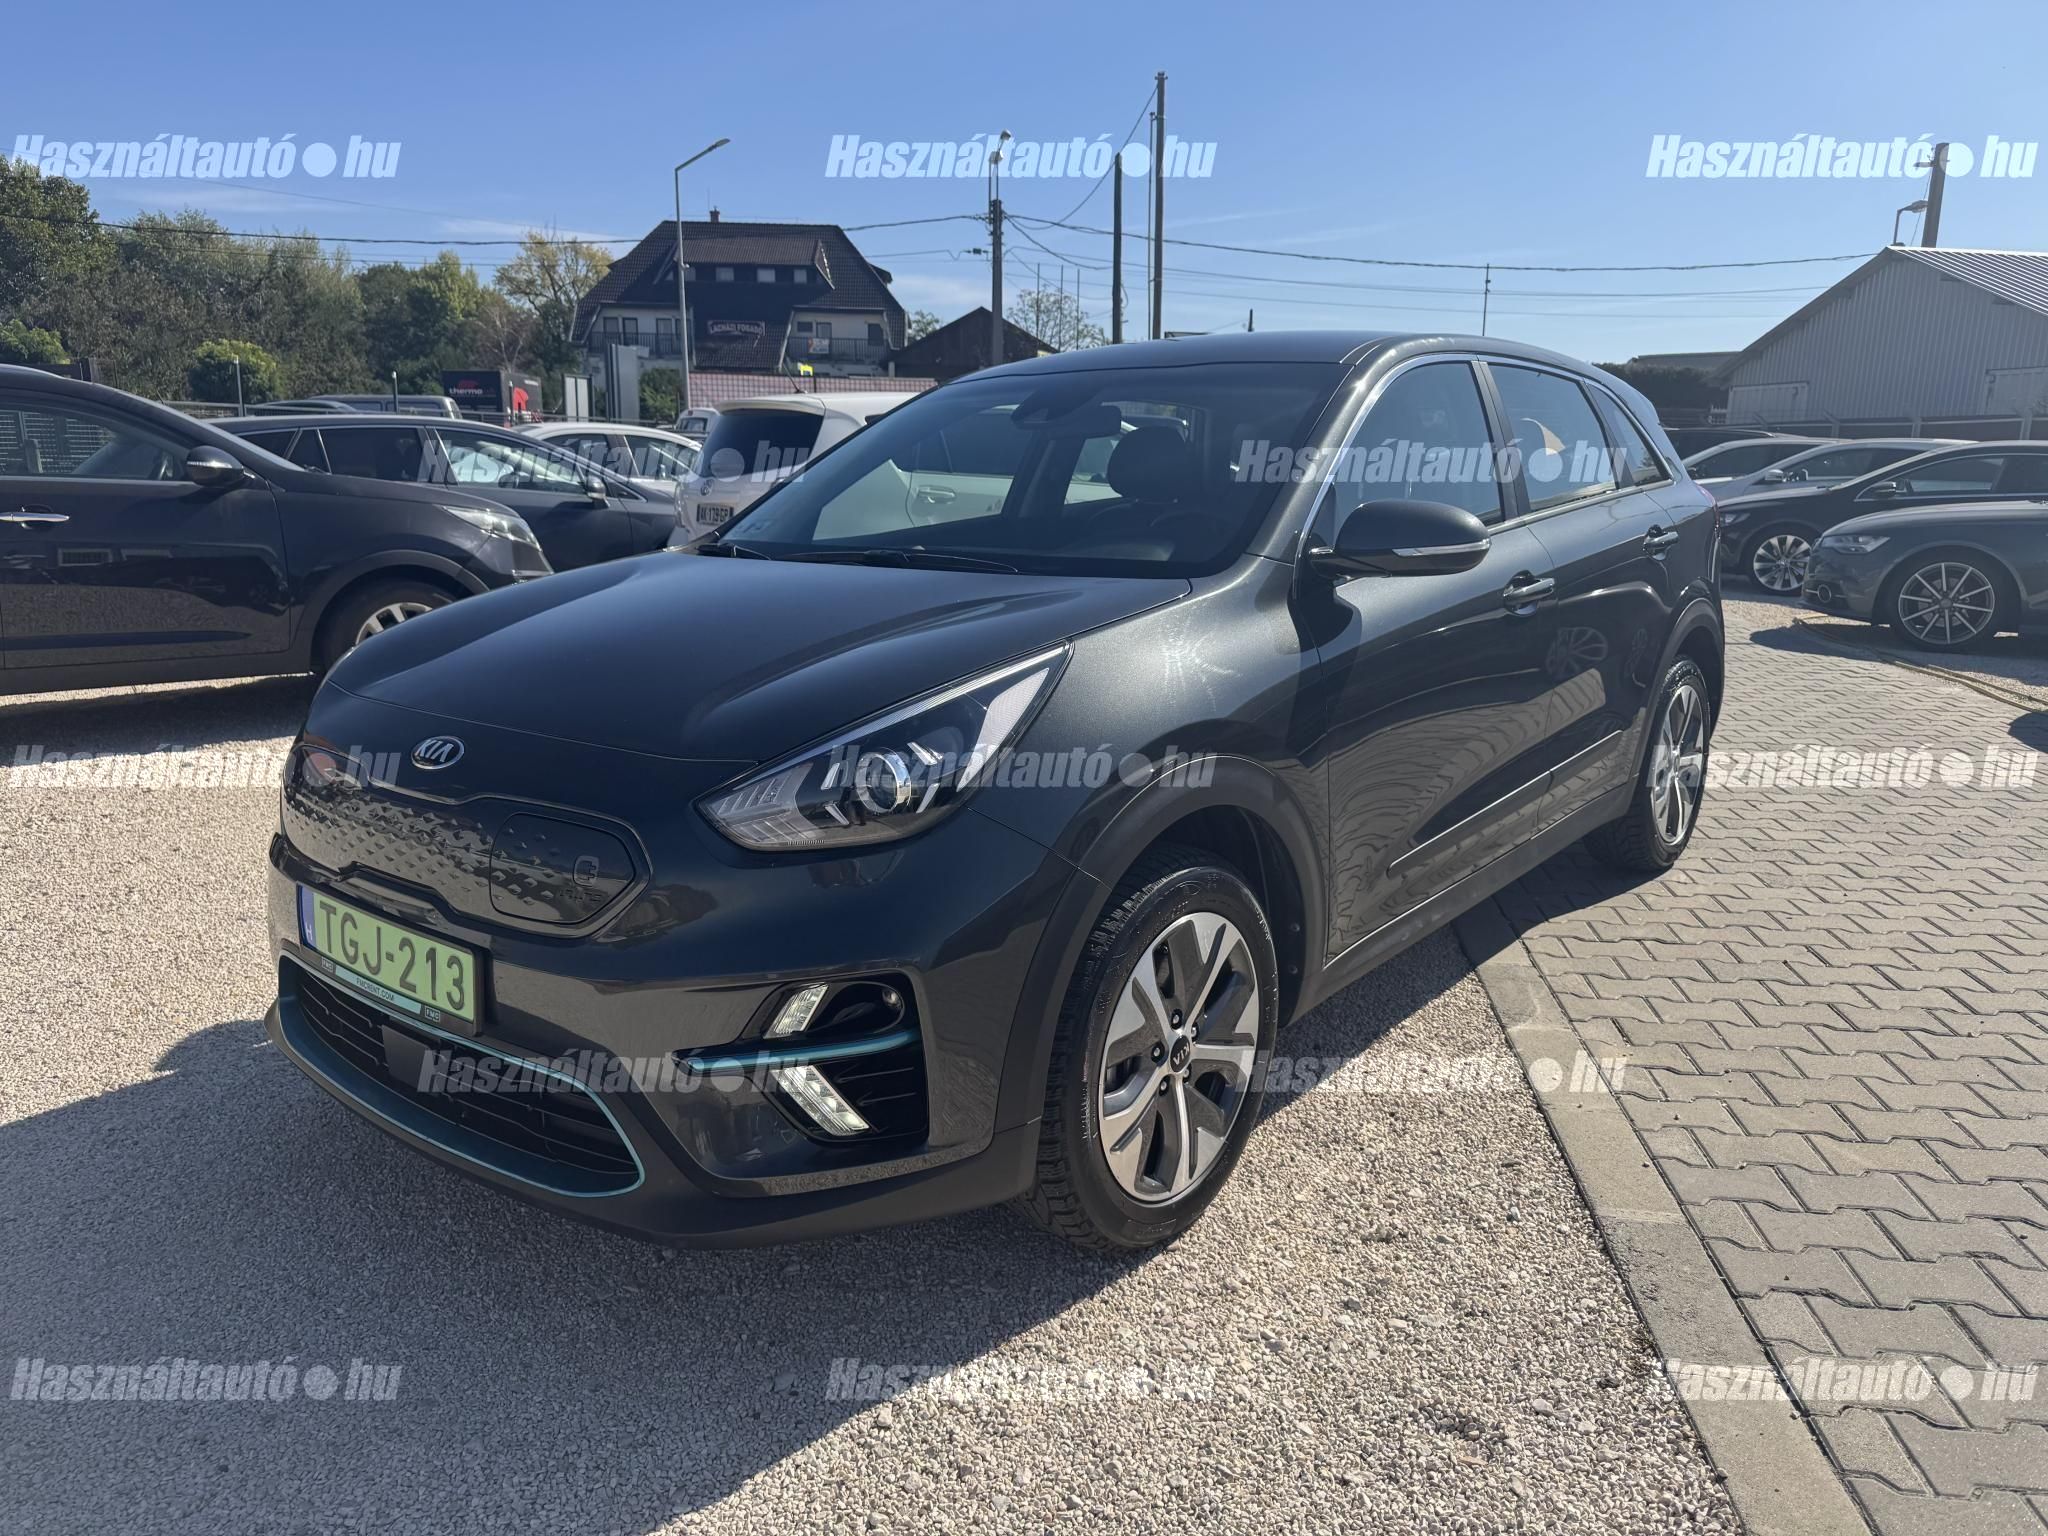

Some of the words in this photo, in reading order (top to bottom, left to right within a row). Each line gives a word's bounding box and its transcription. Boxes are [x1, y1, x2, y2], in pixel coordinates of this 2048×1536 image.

[414, 739, 454, 763] KIA
[319, 900, 465, 1011] TGJ-213
[356, 977, 395, 1001] FMCRENT.COM
